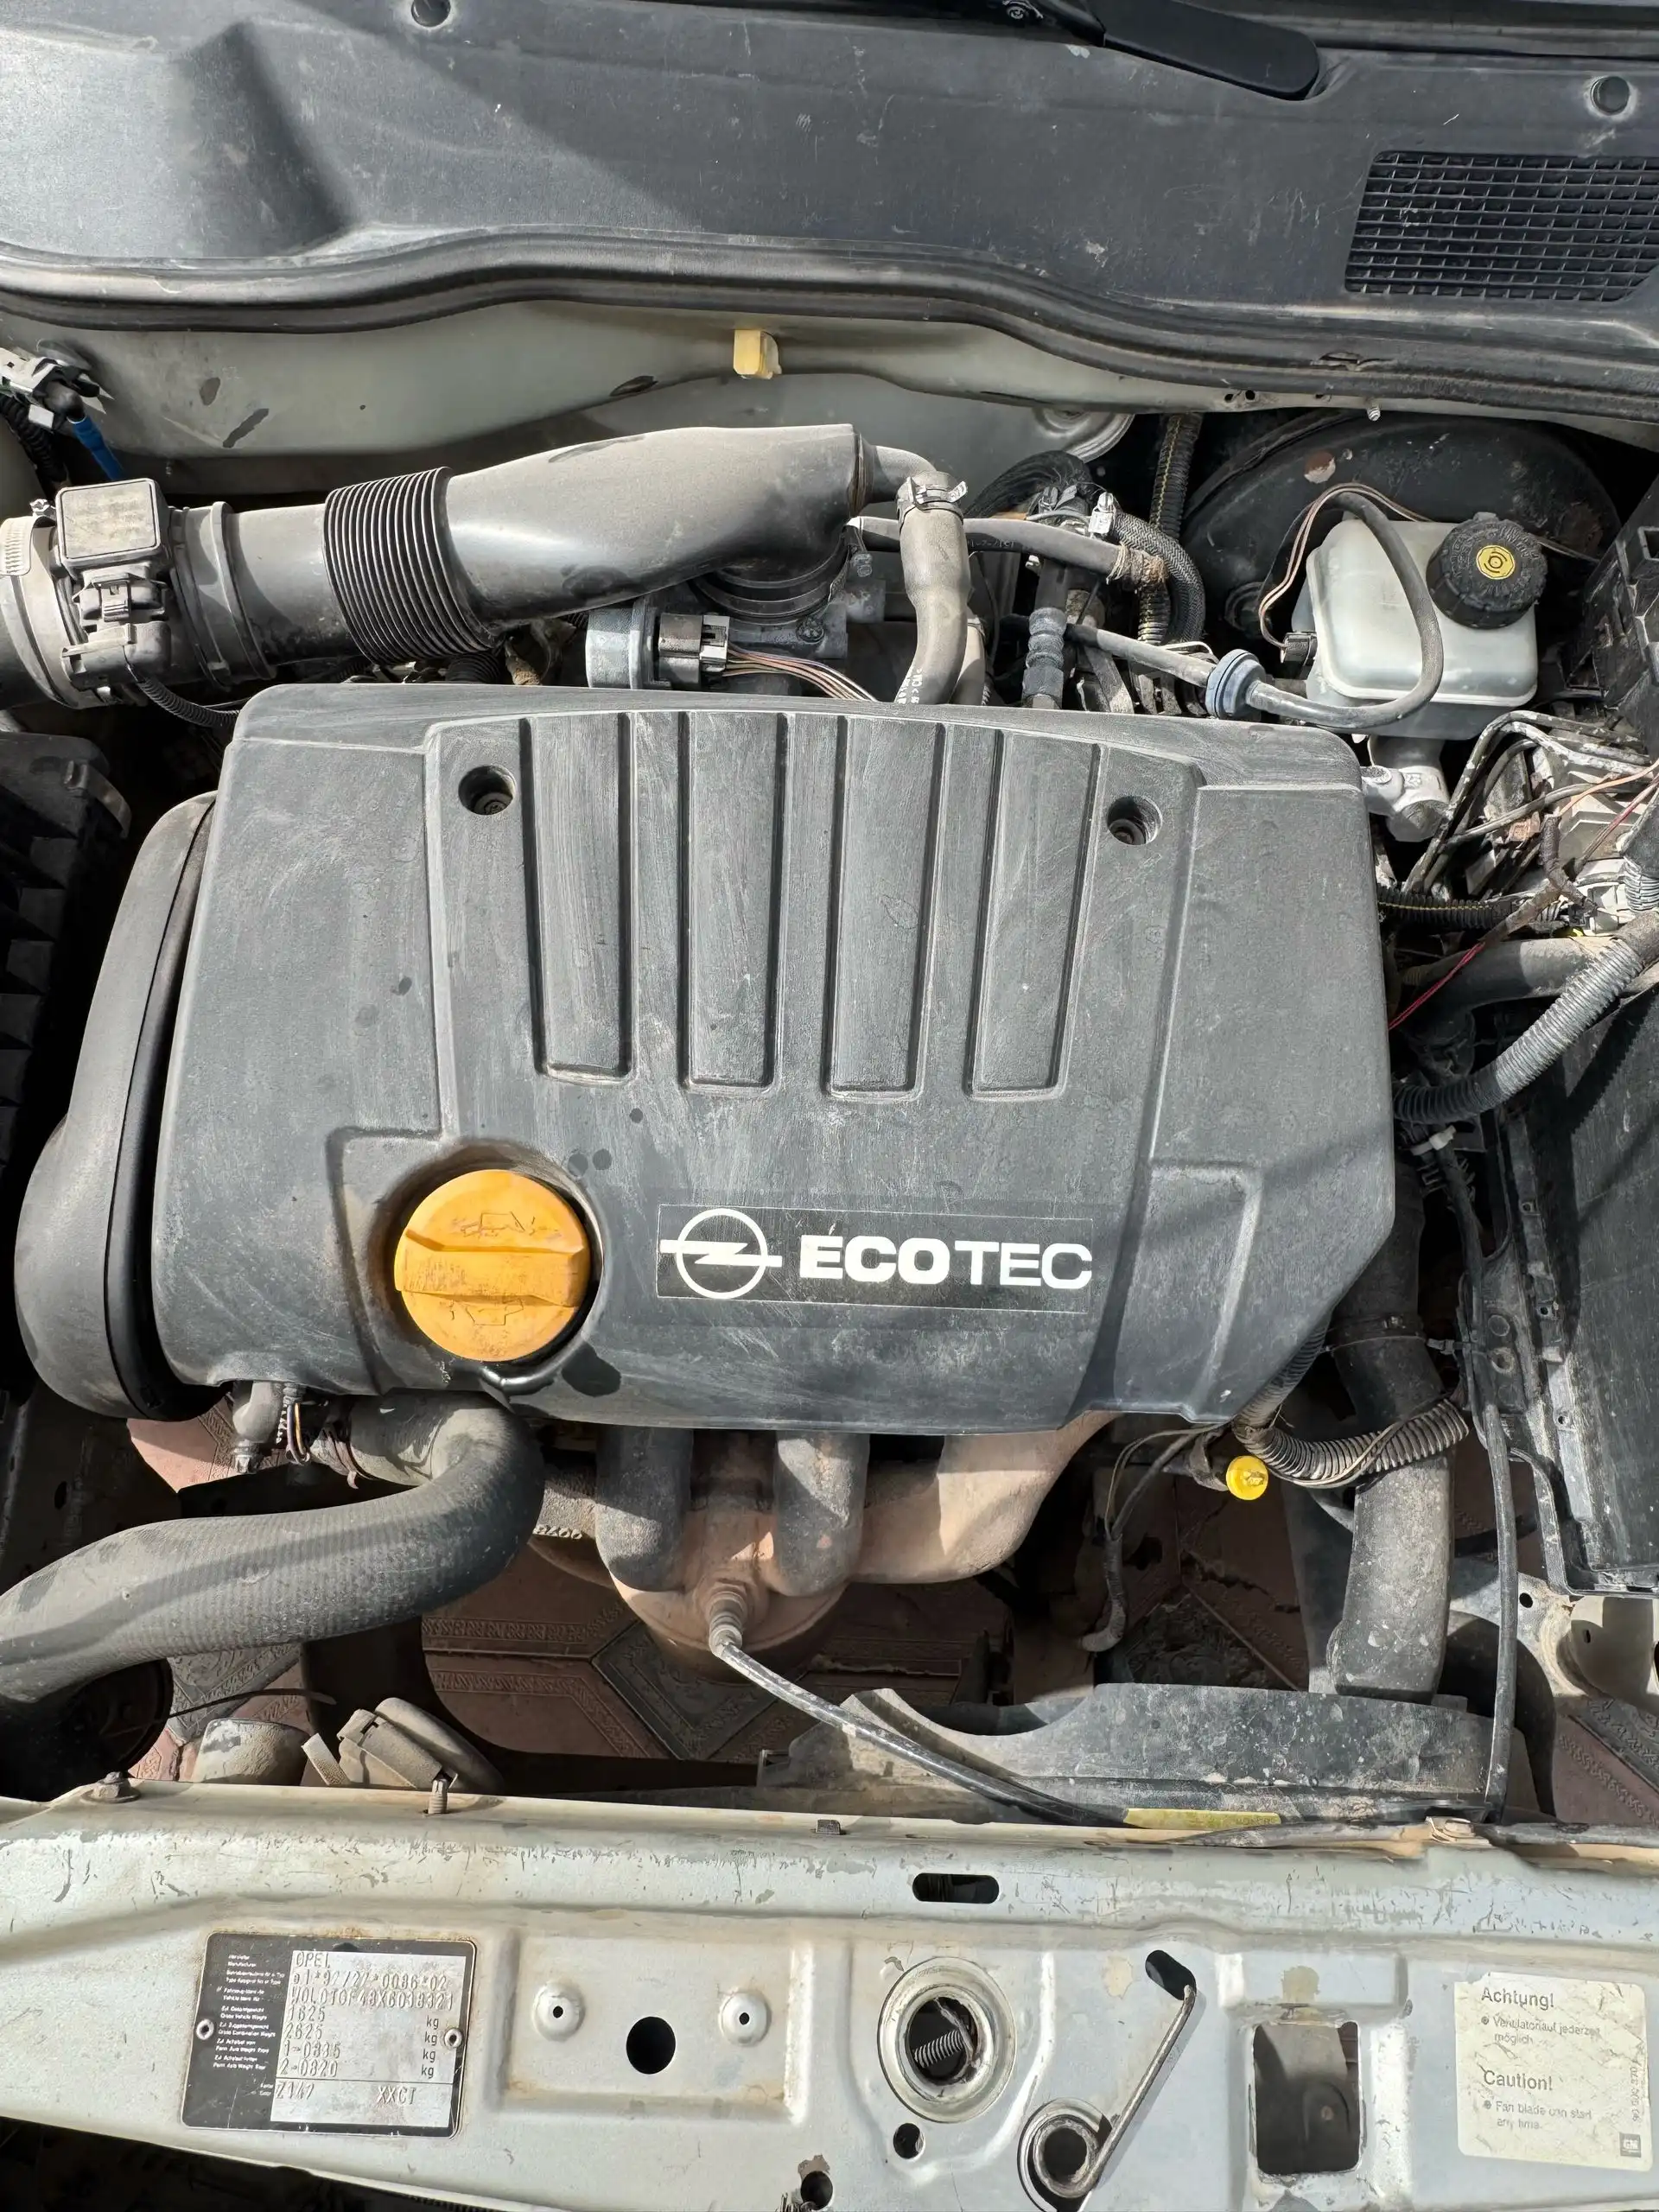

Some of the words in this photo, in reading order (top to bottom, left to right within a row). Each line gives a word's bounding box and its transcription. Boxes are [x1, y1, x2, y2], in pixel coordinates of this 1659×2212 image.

[800, 1235, 1092, 1289] ECOTEC
[296, 1951, 331, 1969] OPEL
[1481, 1986, 1554, 2011] Achtung!
[426, 2015, 440, 2030] kg
[424, 2031, 438, 2046] kg
[423, 2049, 436, 2063] kg
[421, 2064, 435, 2079] kg
[1483, 2069, 1553, 2091] Caution!
[1496, 2101, 1514, 2113] Fan
